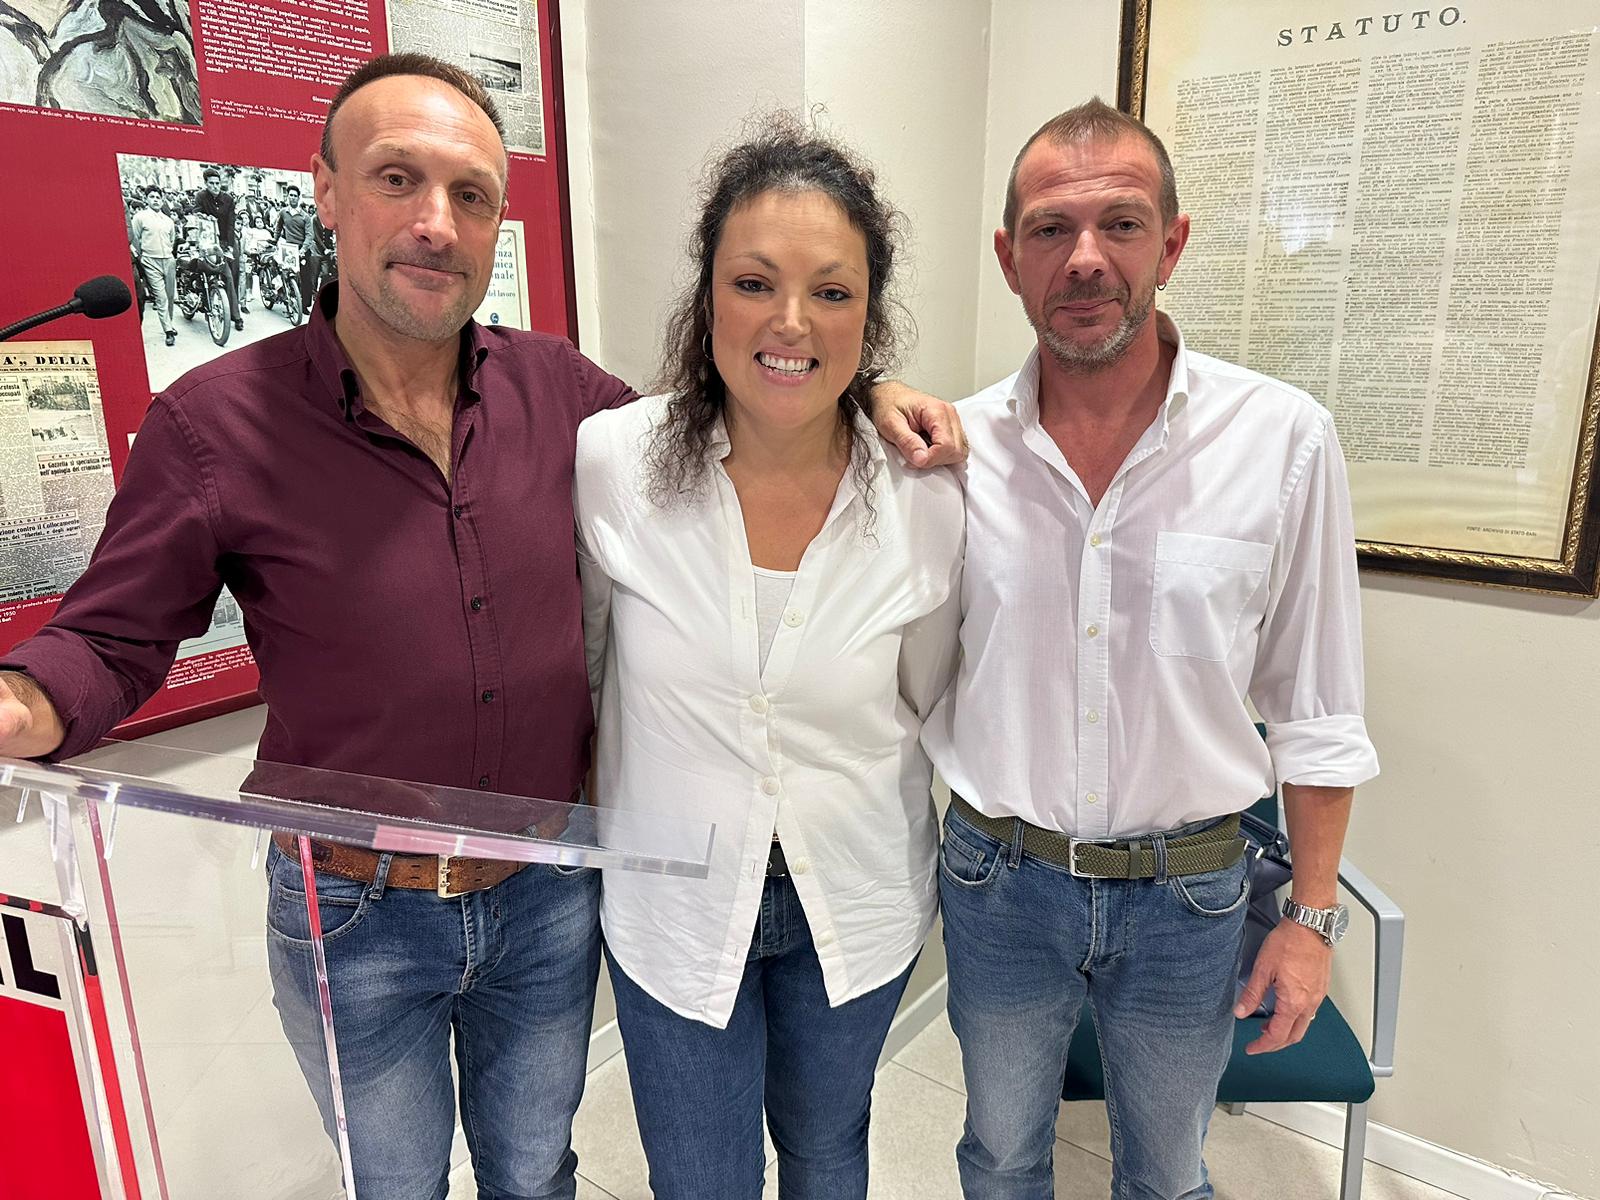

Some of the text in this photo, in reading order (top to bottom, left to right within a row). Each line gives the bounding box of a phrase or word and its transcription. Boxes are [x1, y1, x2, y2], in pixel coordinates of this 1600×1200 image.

[495, 250, 513, 258] nza
[491, 270, 514, 280] nale
[35, 356, 90, 365] DELLA
